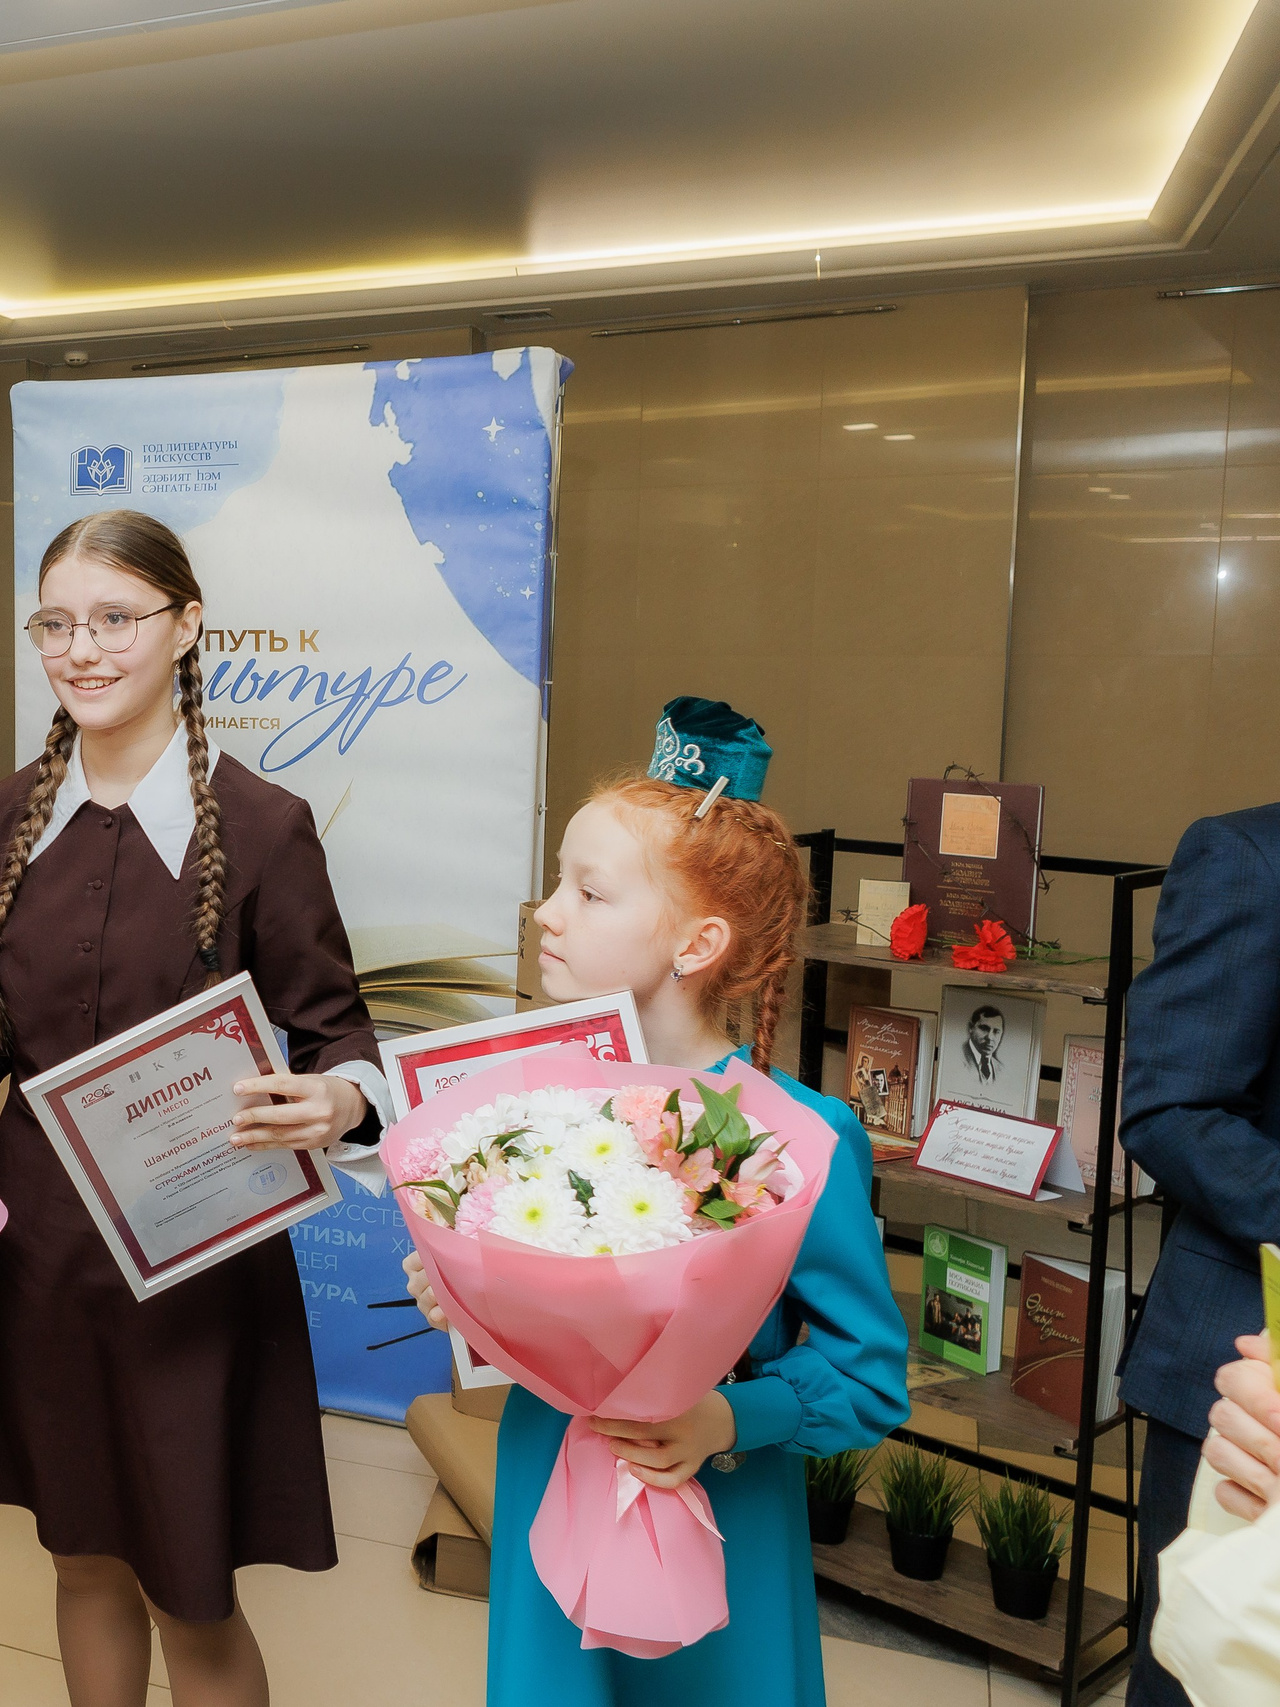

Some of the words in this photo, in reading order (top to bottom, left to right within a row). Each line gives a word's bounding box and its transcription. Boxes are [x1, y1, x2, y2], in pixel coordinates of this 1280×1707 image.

[143, 444, 164, 453] ГОД
[166, 441, 238, 452] ЛИТЕРАТУРЫ
[154, 453, 211, 462] ИСКУССТВ
[142, 484, 191, 493] СӘНГАТЬ
[194, 483, 217, 492] ЕЛЫ
[204, 629, 288, 652] ПУТЬ
[300, 629, 320, 652] К
[202, 652, 468, 772] льтуре
[205, 717, 280, 730] ИНАЕТСЯ
[125, 1066, 213, 1123] ДИПЛОМ
[163, 1098, 189, 1114] МЕСТО
[144, 1135, 198, 1169] Шакирова
[199, 1117, 233, 1140] Айсыл
[155, 1164, 201, 1191] СТРОКАМИ
[296, 1250, 338, 1271] ДЕЯ
